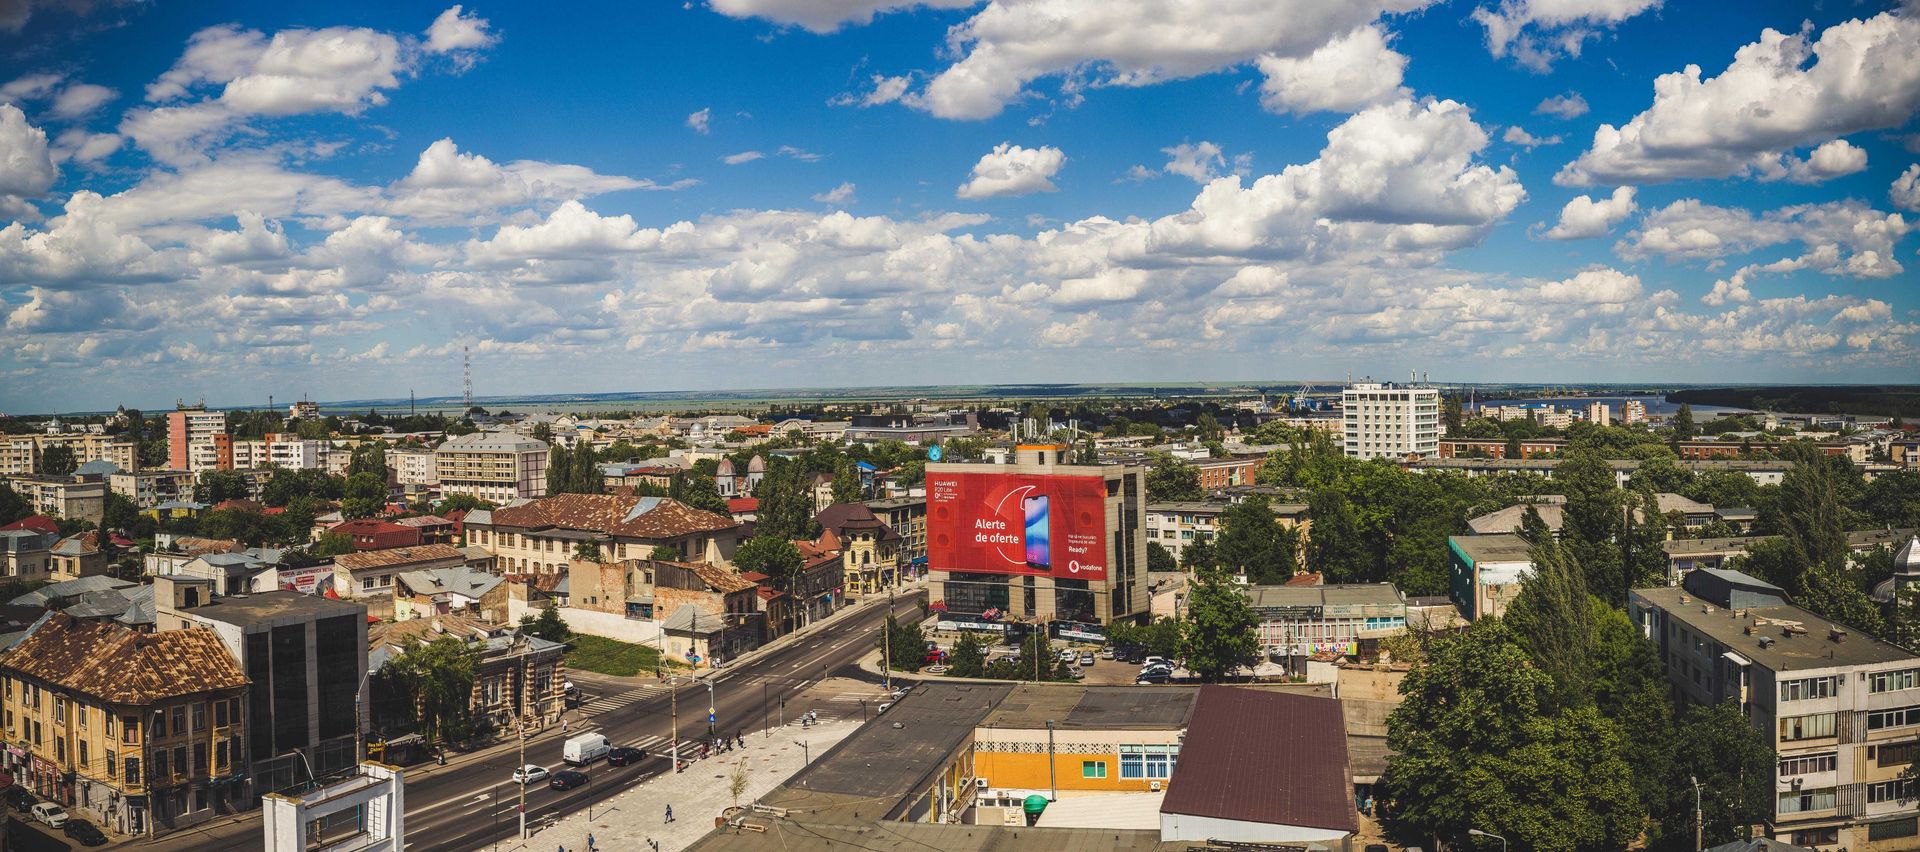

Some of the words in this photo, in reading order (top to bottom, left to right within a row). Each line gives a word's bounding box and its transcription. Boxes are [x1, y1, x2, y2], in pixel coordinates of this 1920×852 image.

[975, 518, 1006, 529] Alerte
[976, 532, 988, 542] de
[990, 532, 1019, 544] oferte
[1068, 546, 1088, 554] Ready?
